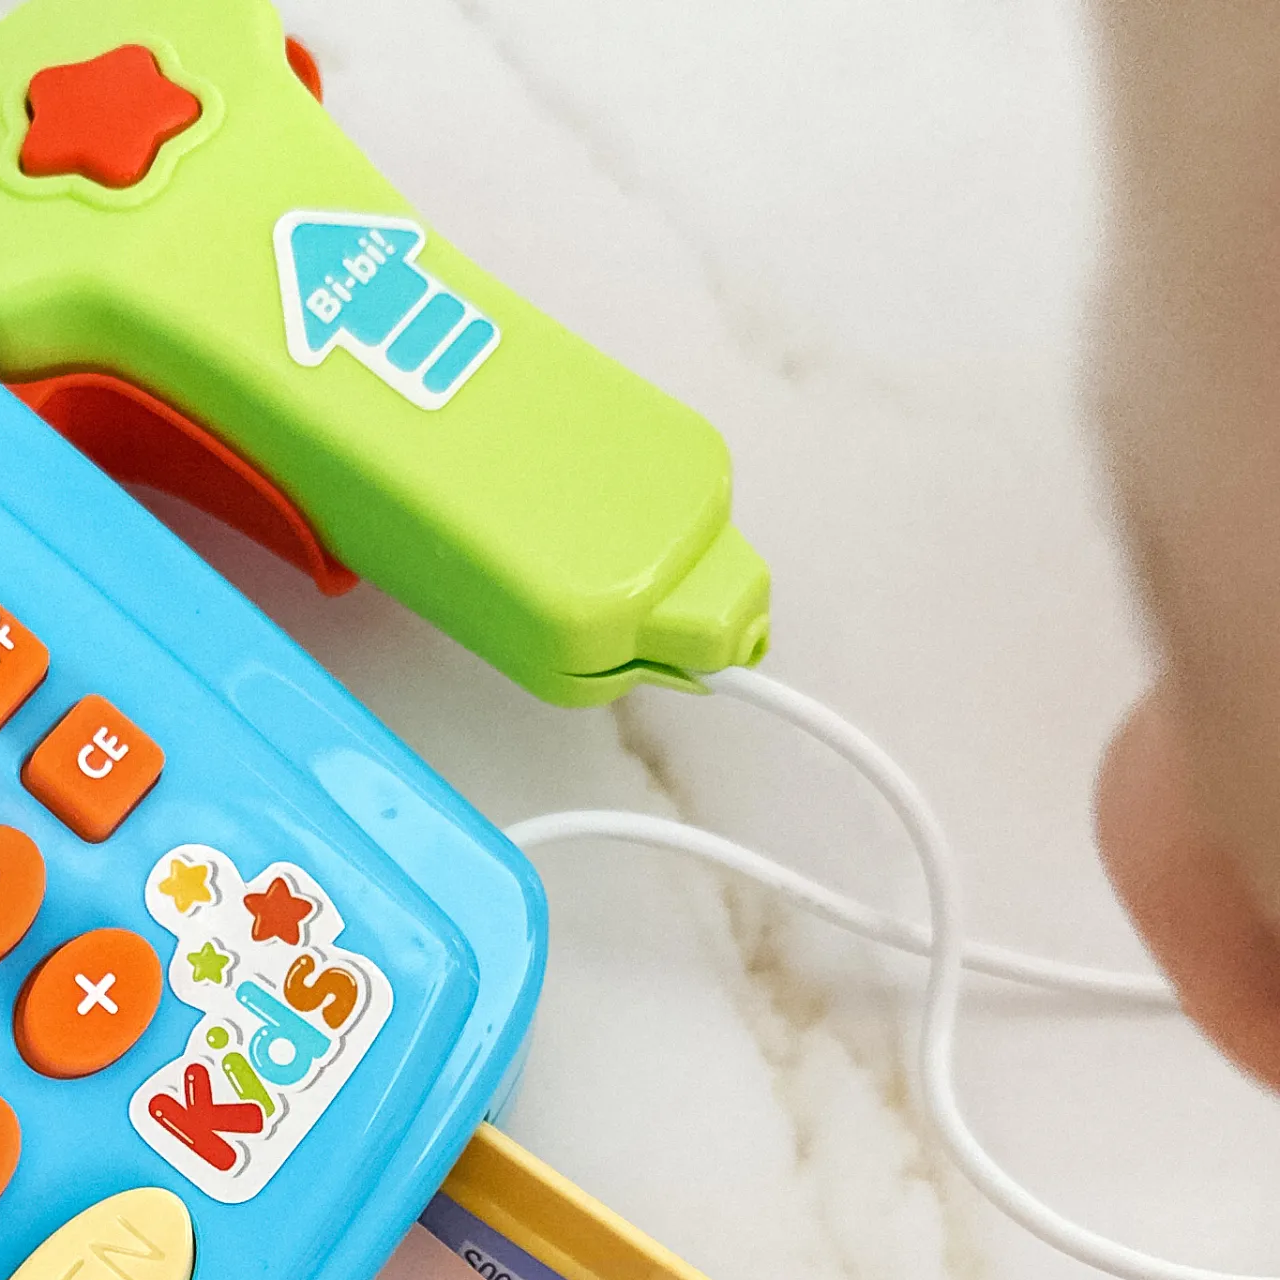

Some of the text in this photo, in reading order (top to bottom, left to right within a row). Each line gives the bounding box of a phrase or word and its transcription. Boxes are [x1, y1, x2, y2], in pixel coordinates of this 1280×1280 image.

[305, 229, 395, 324] Bi-bi!
[76, 726, 130, 780] CE
[148, 953, 361, 1172] Kids
